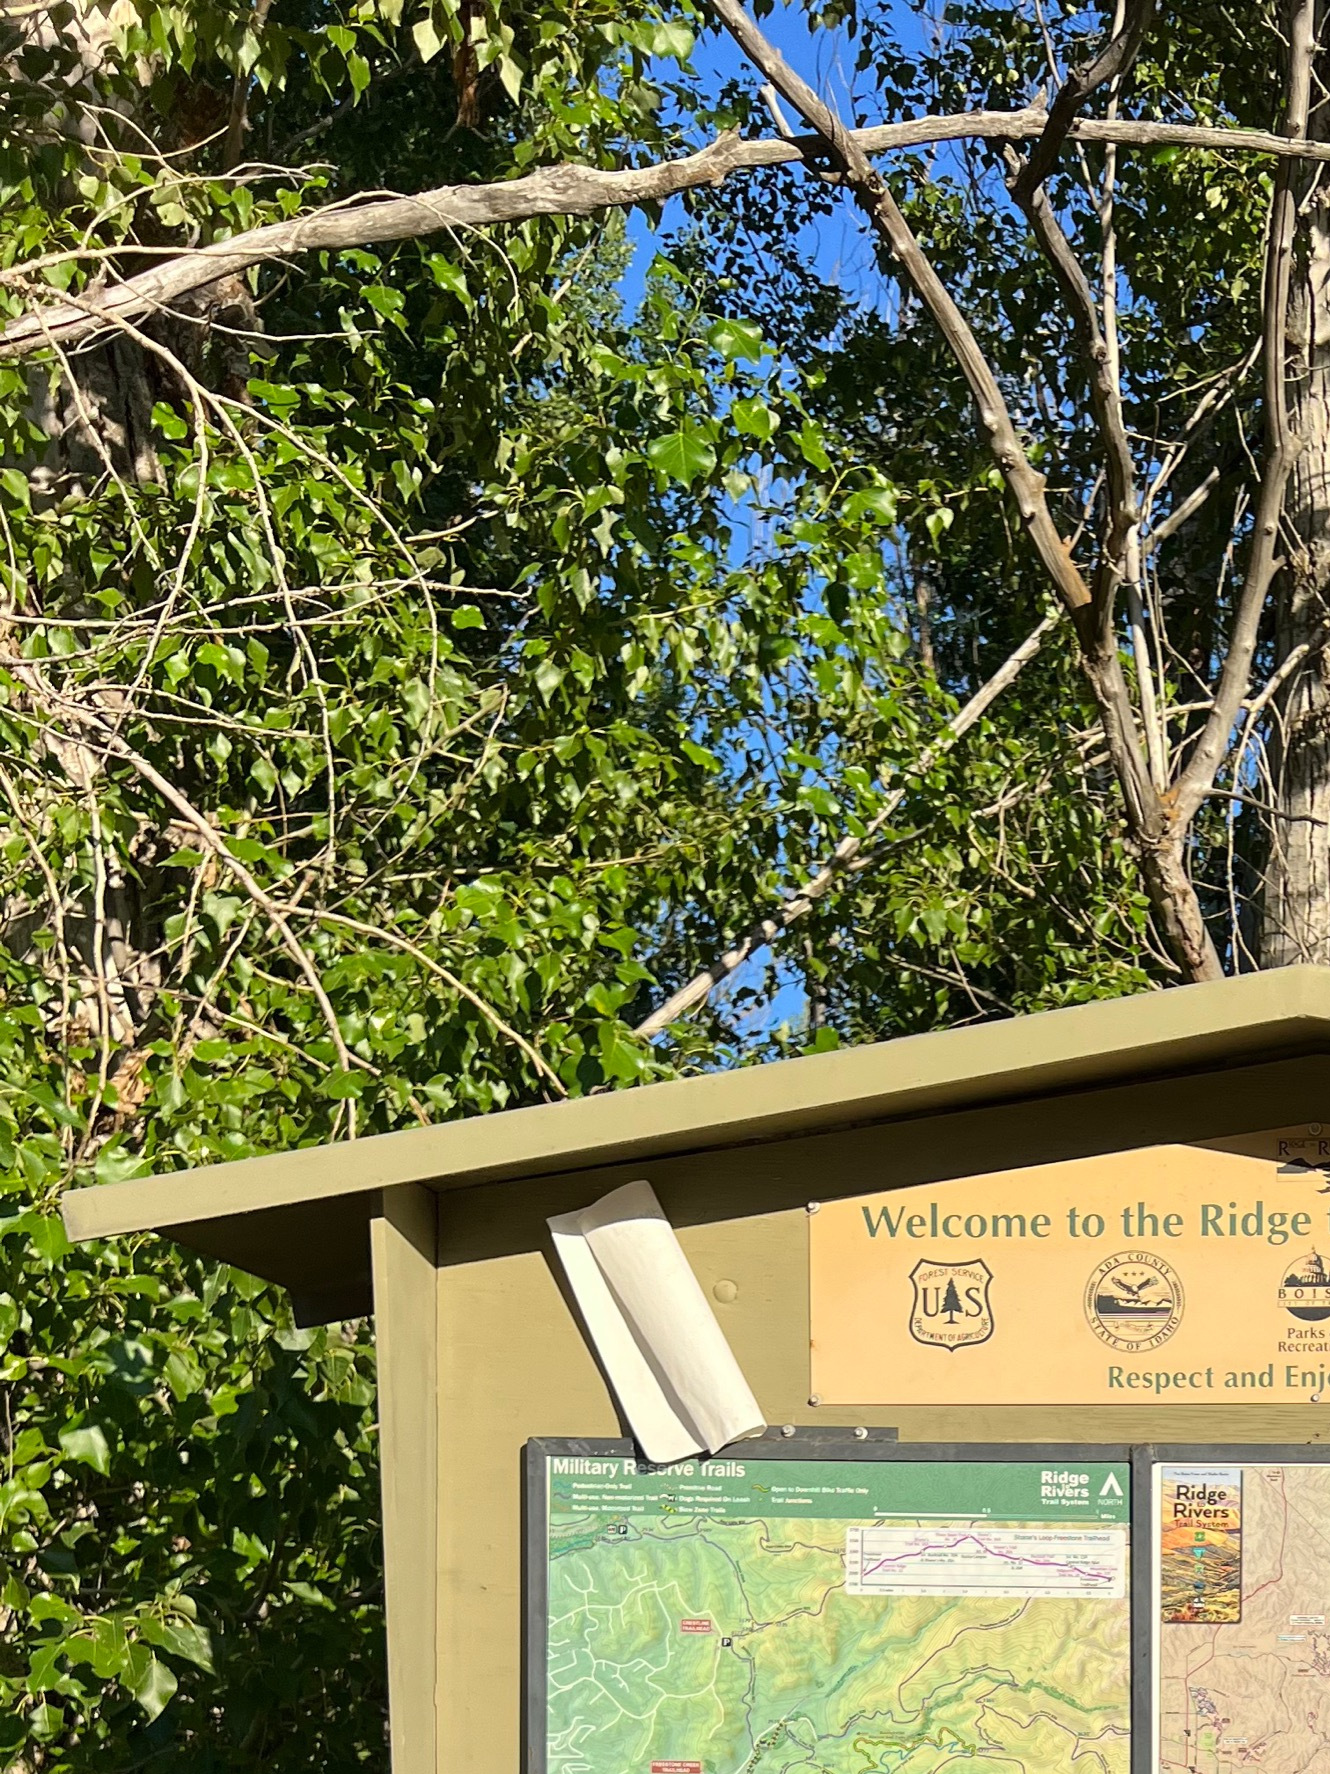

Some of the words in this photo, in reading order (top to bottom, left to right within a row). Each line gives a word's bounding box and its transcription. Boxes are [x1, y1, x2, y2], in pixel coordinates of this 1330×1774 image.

[861, 1203, 1051, 1238] Welcome
[1066, 1207, 1105, 1237] to
[1120, 1203, 1184, 1237] the
[1200, 1201, 1312, 1245] Ridge
[1098, 1257, 1121, 1275] ADA
[1127, 1253, 1173, 1276] COUNTY
[918, 1268, 949, 1284] FOREST
[951, 1268, 984, 1284] SERVICE
[1090, 1316, 1118, 1348] STATE
[1126, 1342, 1141, 1351] OF
[1149, 1316, 1179, 1348] IDAHO
[1287, 1327, 1326, 1339] Parks
[1107, 1364, 1215, 1394] Respect
[1224, 1364, 1274, 1388] and
[553, 1458, 620, 1478] Military
[624, 1460, 694, 1477] Reserve
[699, 1460, 746, 1477] Trails
[1041, 1471, 1090, 1486] Ridge
[1041, 1485, 1090, 1498] Rivers
[1176, 1483, 1227, 1505] Ridge
[1041, 1498, 1060, 1506] Trail
[1061, 1499, 1090, 1507] System
[1174, 1503, 1229, 1518] Rivers
[1174, 1519, 1194, 1528] Trail
[1195, 1519, 1230, 1528] System
